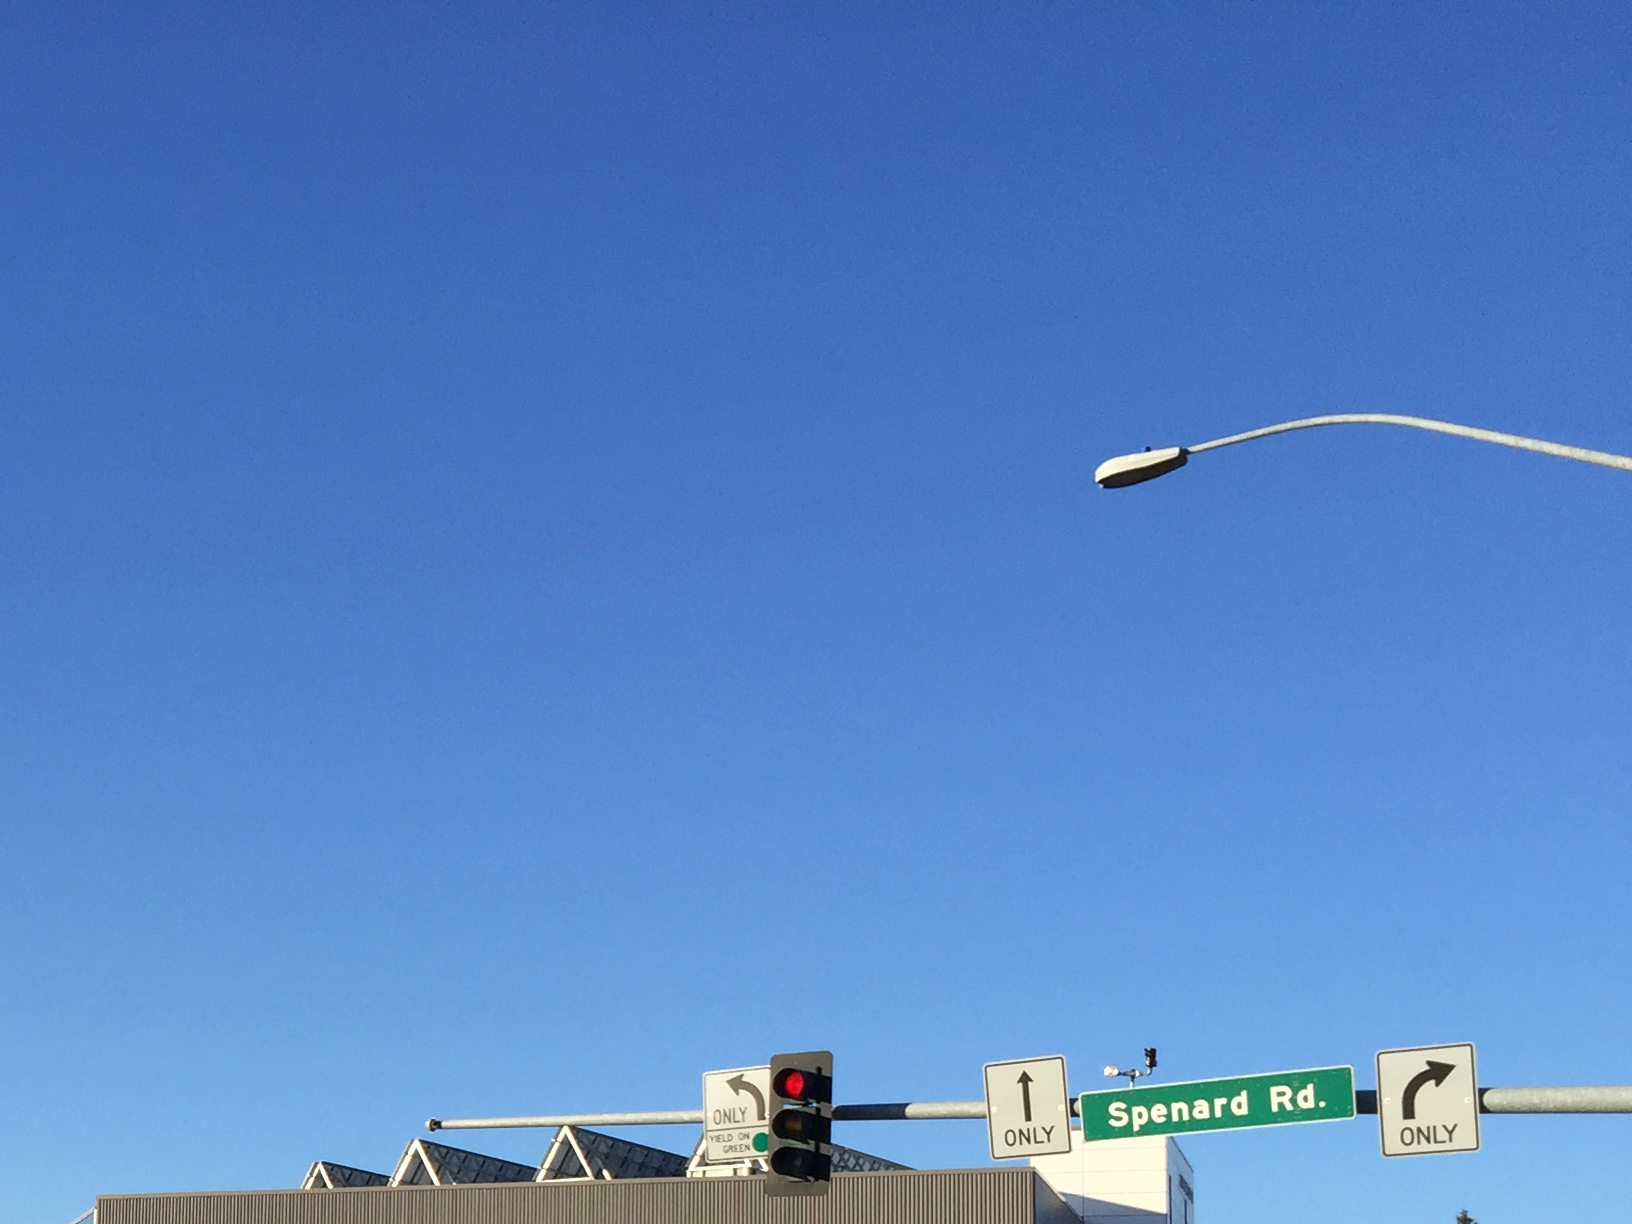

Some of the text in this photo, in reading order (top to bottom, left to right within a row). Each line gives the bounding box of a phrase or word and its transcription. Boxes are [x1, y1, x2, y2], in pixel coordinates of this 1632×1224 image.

[713, 1107, 747, 1125] ONLY
[1108, 1083, 1326, 1132] Spenard Rd.
[709, 1132, 750, 1143] YIELD ON
[1004, 1125, 1055, 1147] ONLY
[1400, 1123, 1458, 1147] ONLY
[722, 1144, 751, 1153] GREEN
